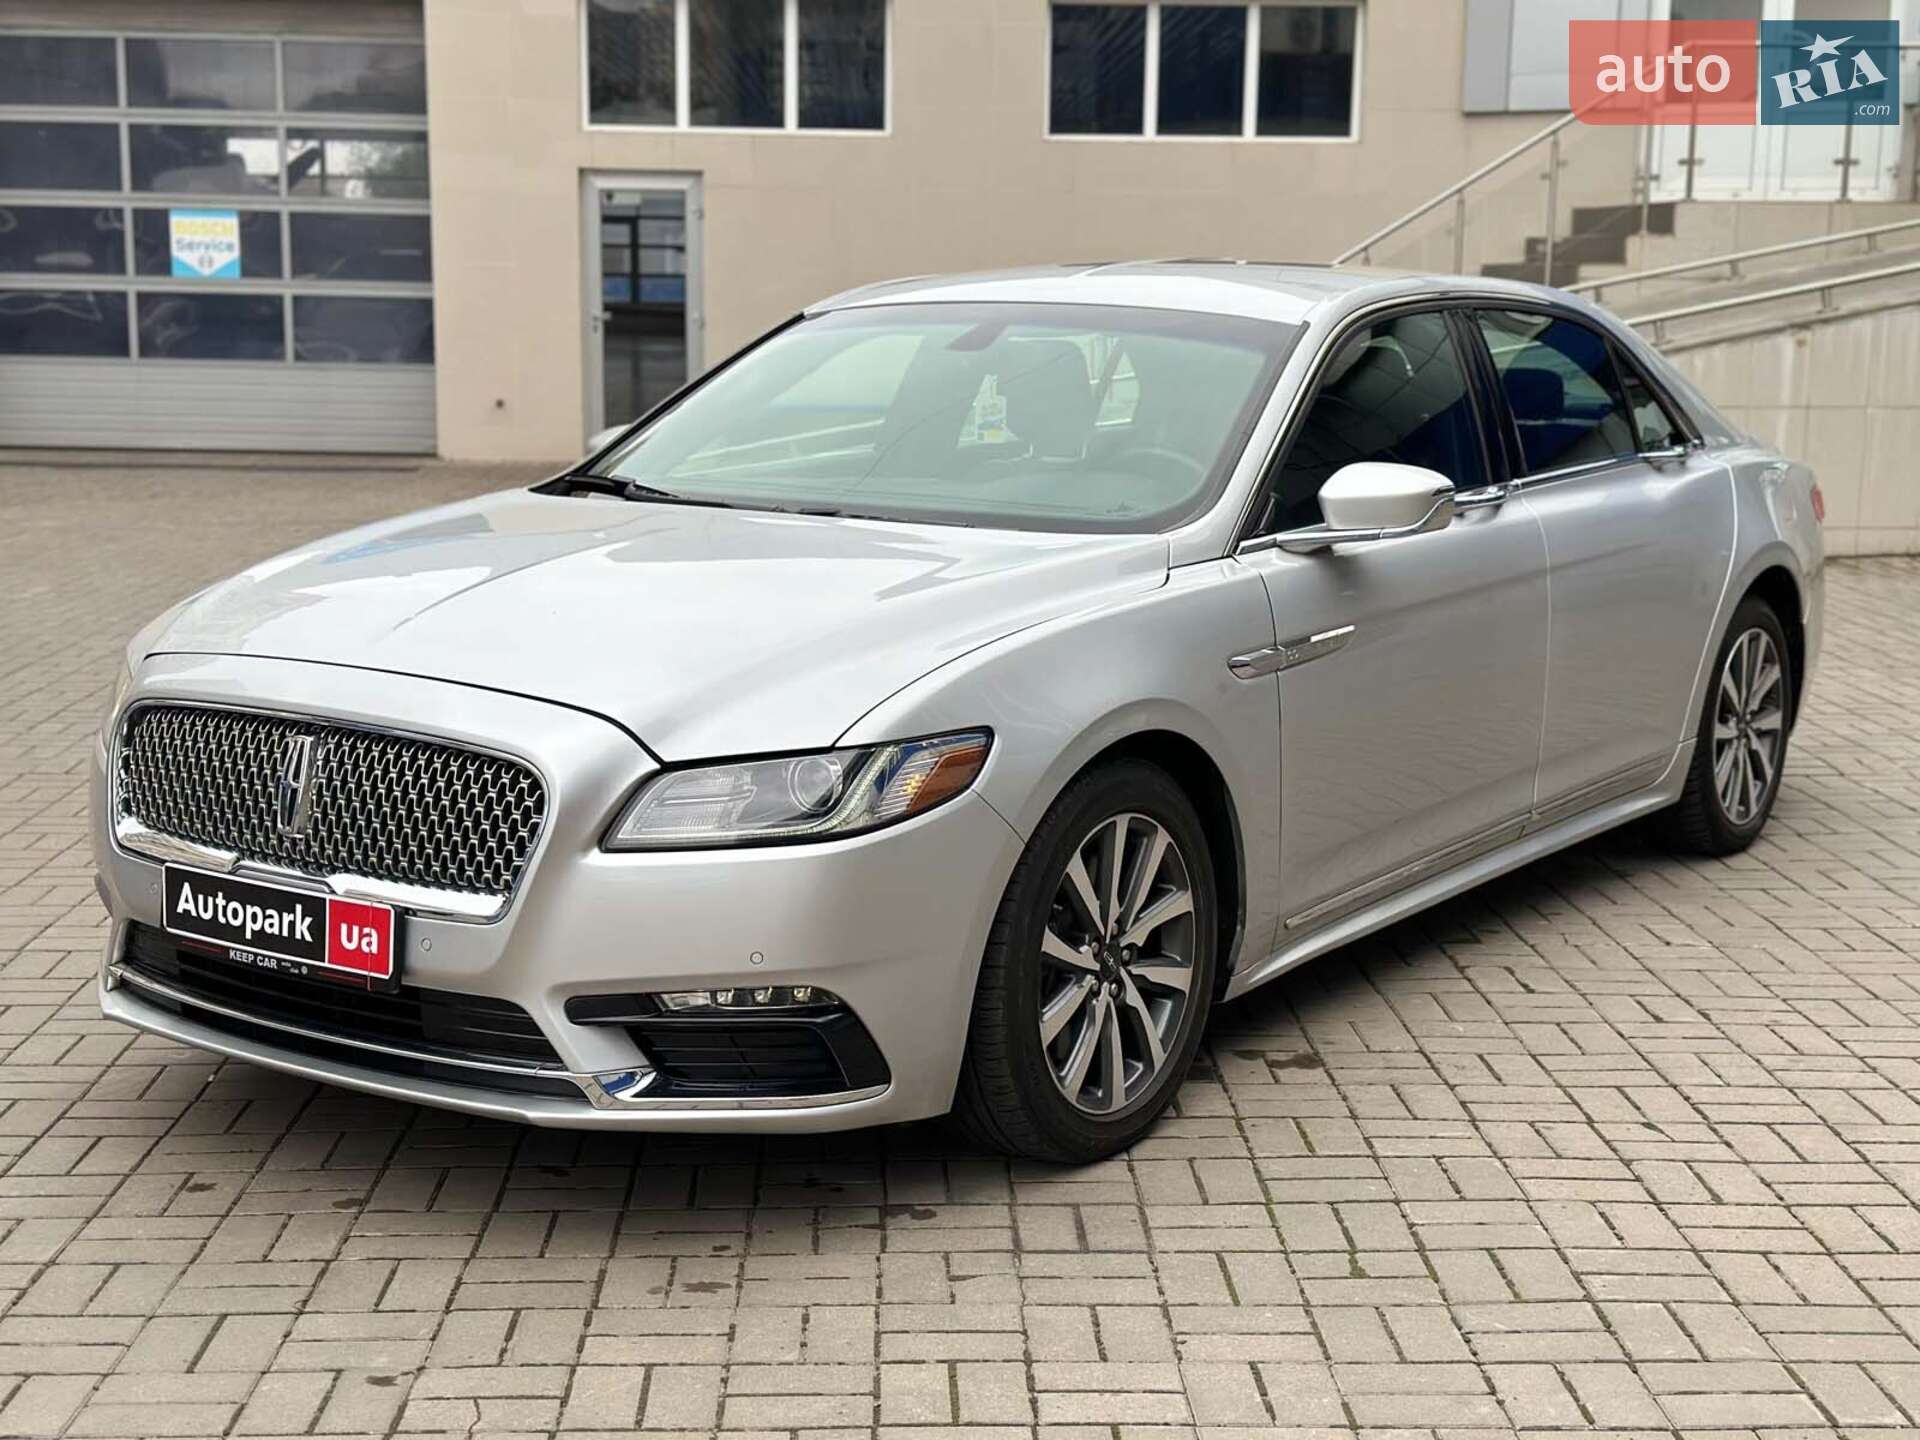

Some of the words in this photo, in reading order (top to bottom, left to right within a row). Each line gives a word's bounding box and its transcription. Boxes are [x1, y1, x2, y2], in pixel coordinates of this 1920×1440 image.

[176, 237, 234, 252] Service
[177, 882, 313, 942] Autopark
[340, 922, 378, 954] ua
[229, 949, 254, 964] KEEP
[257, 956, 278, 969] CAR
